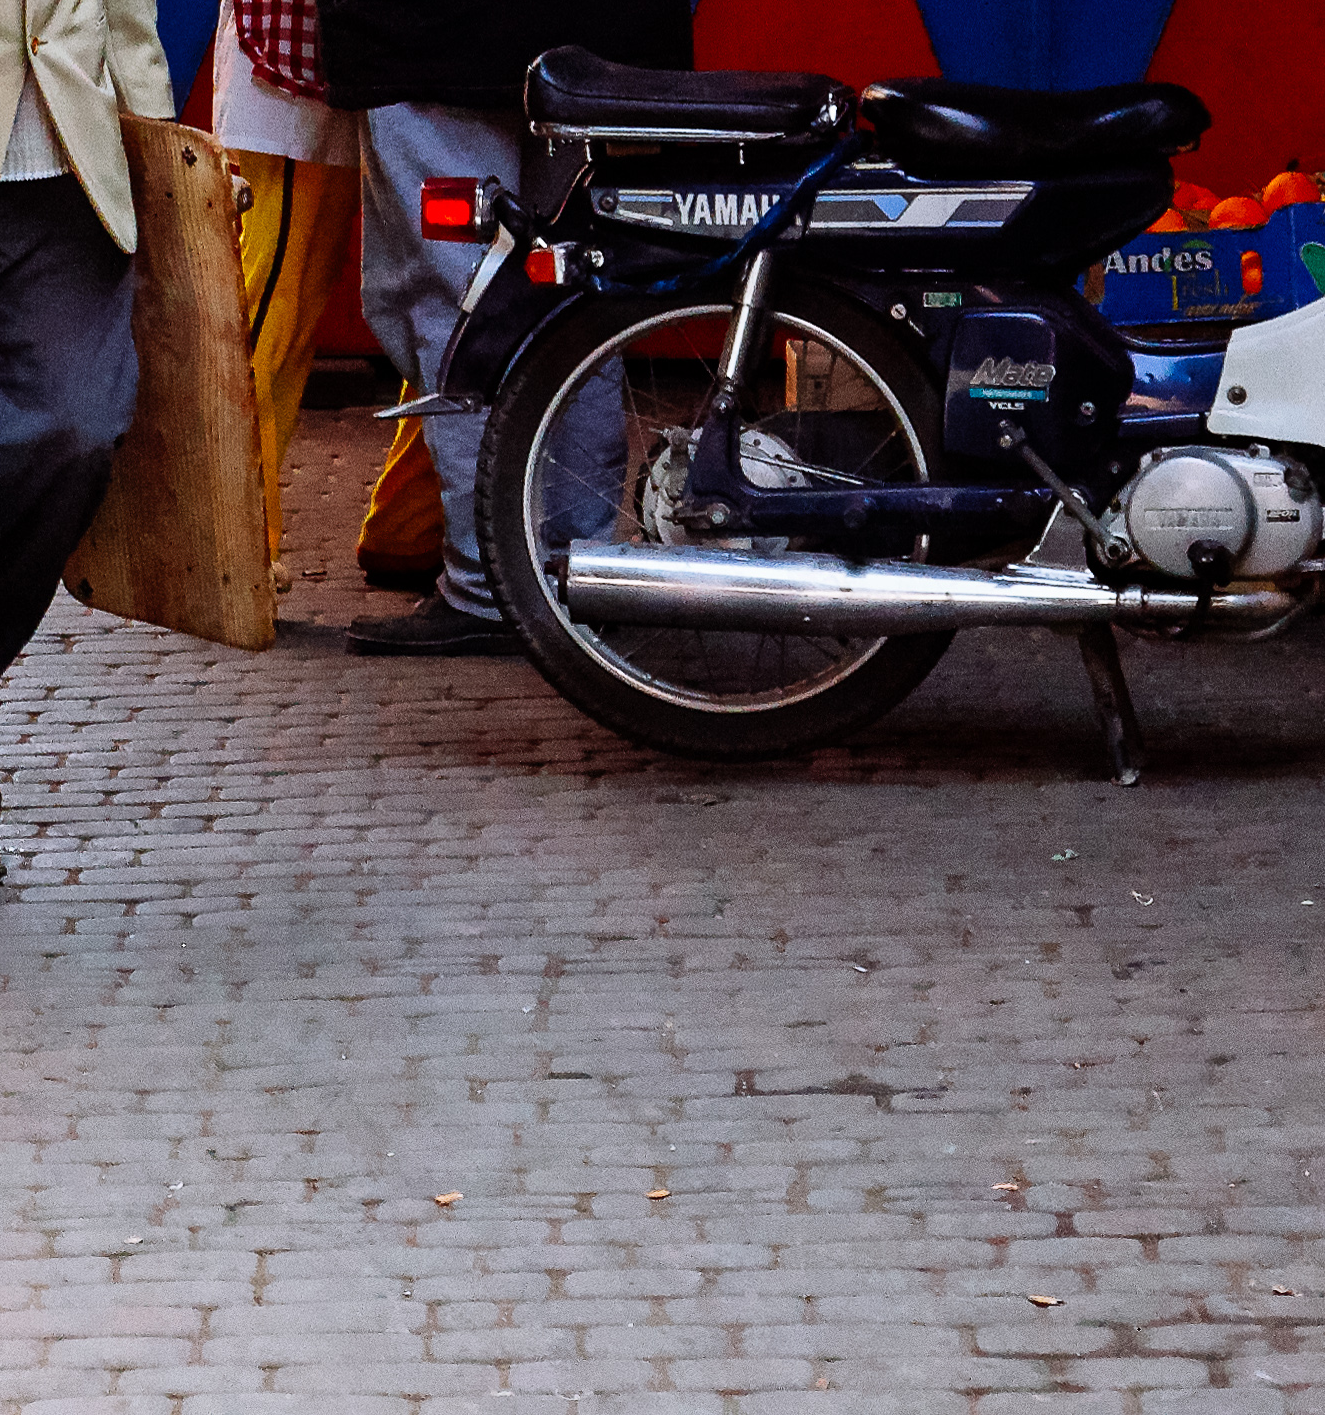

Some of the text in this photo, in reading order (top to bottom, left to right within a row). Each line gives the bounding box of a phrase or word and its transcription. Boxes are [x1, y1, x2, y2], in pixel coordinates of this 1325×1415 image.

[674, 192, 782, 227] YAMAH
[1103, 246, 1214, 275] Andes
[969, 355, 1056, 388] Mate
